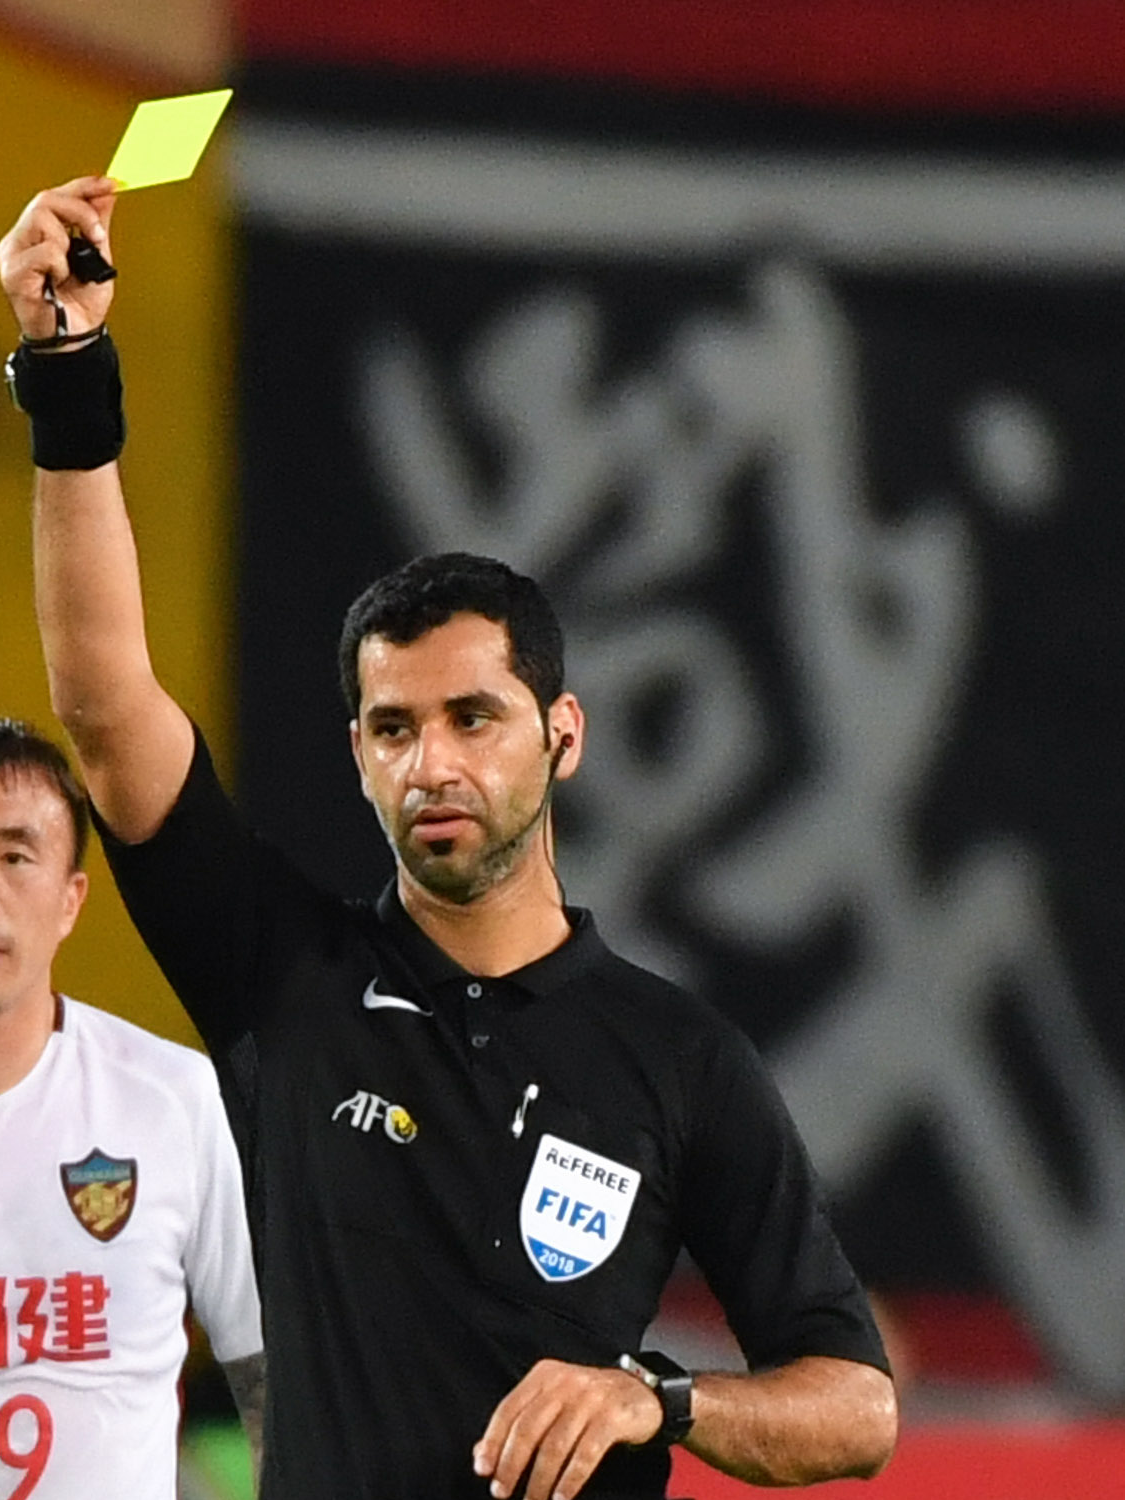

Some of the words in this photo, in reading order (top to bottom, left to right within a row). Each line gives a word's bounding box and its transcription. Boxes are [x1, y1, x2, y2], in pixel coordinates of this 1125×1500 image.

[332, 1090, 417, 1143] AFC
[545, 1147, 630, 1194] REFEREE
[535, 1186, 606, 1240] FIFA
[539, 1248, 575, 1273] 2018
